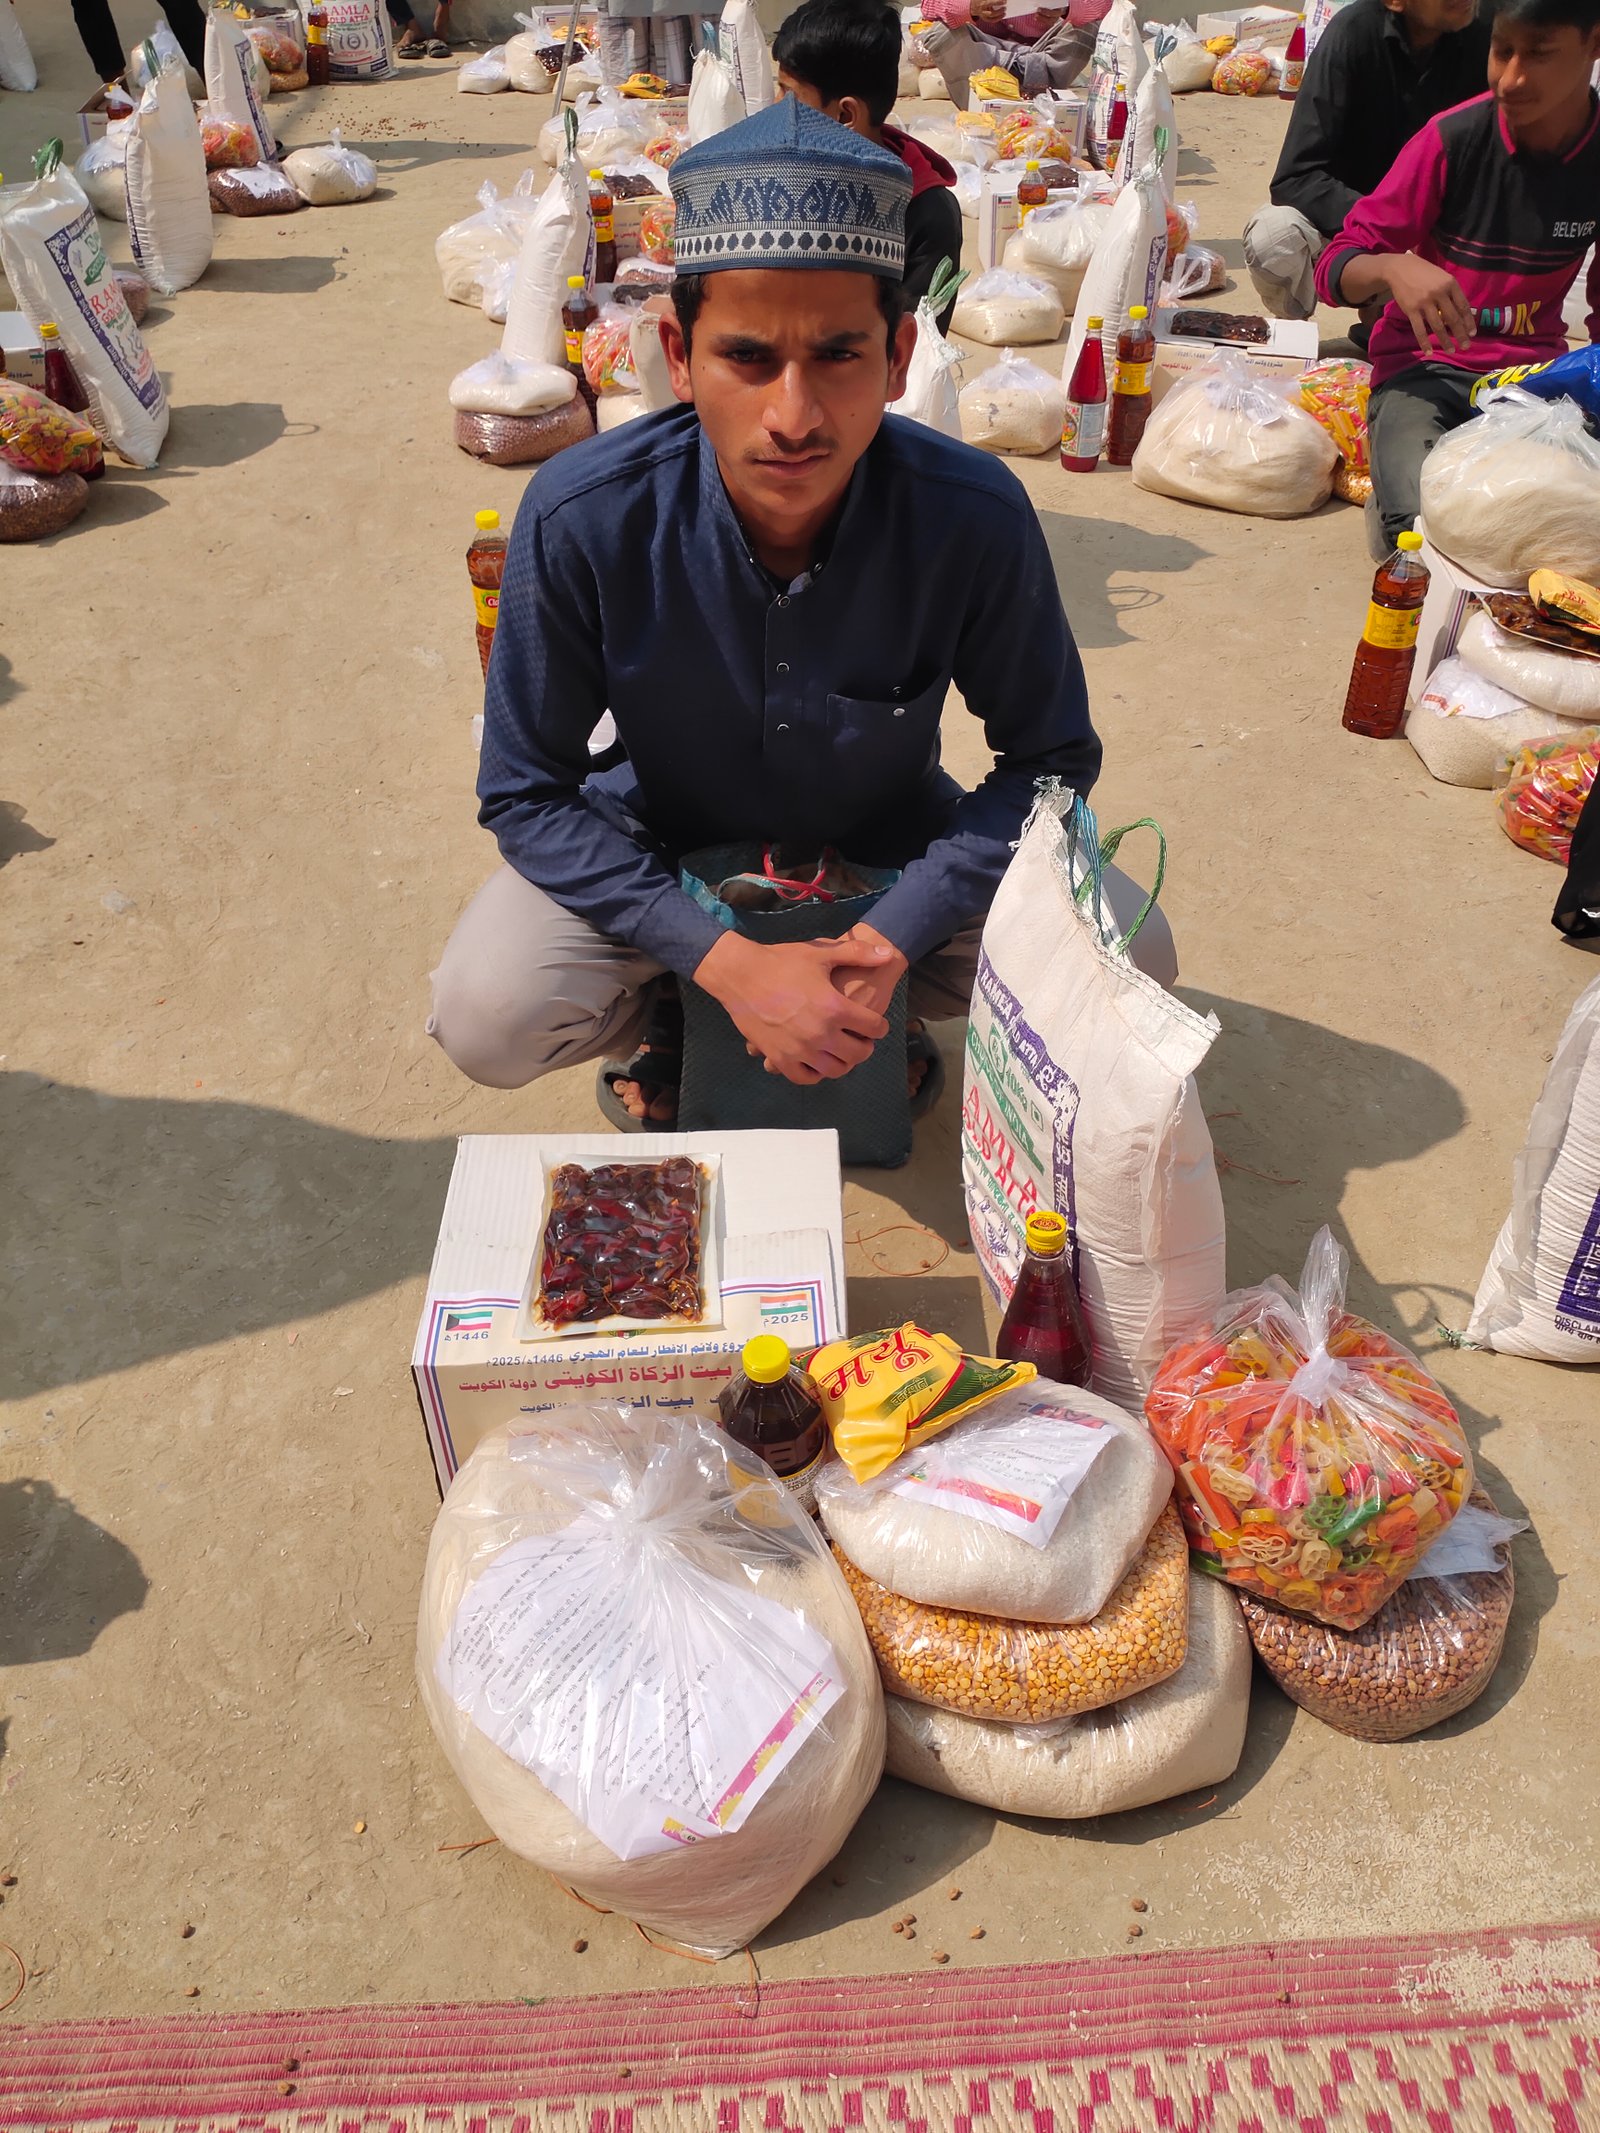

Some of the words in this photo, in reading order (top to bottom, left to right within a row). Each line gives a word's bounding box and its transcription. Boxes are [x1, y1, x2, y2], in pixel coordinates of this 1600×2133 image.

[328, 16, 347, 24] OLD
[967, 1084, 1038, 1202] AMLA
[1554, 1314, 1600, 1334] DISCLAIM
[629, 1364, 684, 1384] الزكاة
[689, 1364, 733, 1381] بيت
[459, 1378, 506, 1393] الكويت
[509, 1378, 538, 1392] دولة
[655, 1395, 694, 1410] بيت
[816, 1678, 824, 1687] 70
[686, 1834, 697, 1843] 69
